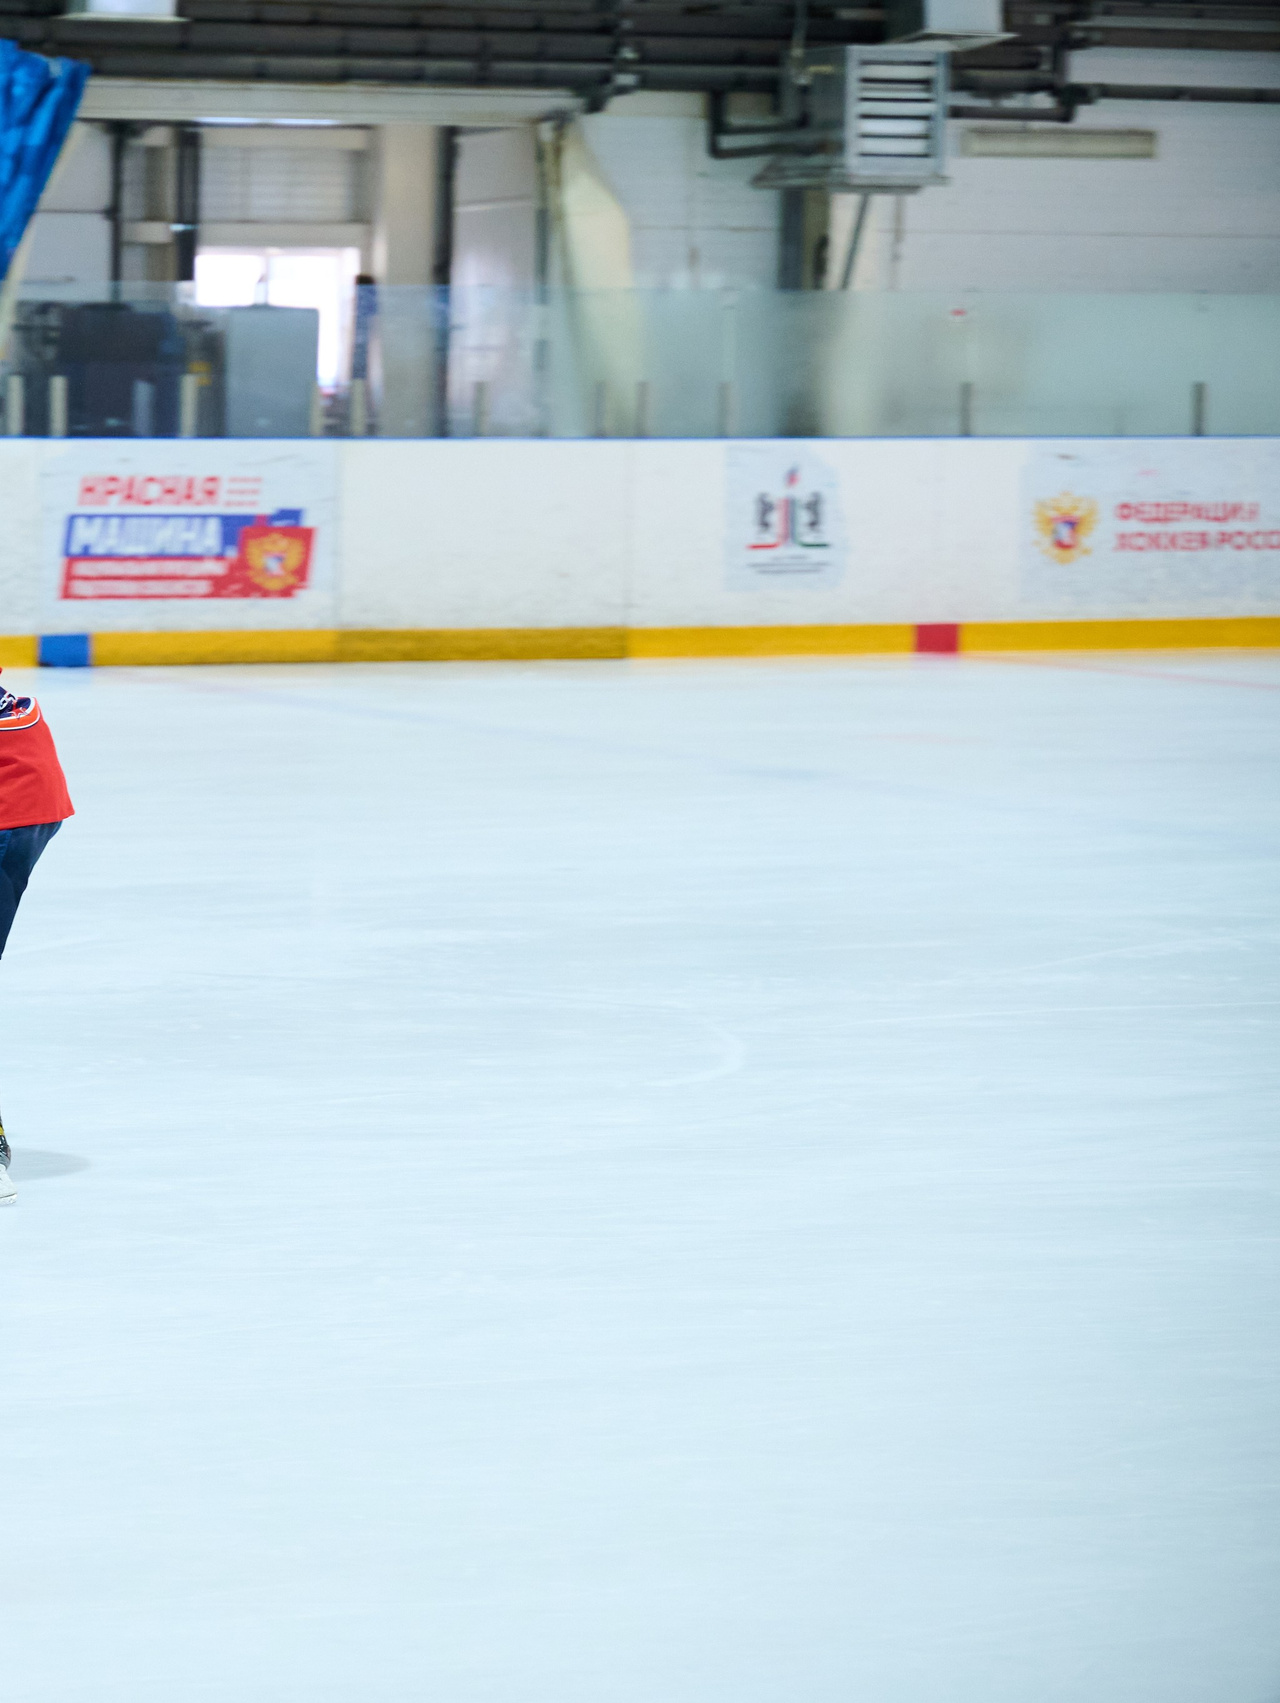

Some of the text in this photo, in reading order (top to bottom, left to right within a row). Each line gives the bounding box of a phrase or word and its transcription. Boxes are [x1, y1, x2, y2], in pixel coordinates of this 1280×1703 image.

[78, 475, 221, 506] КРАСНАЯ
[1116, 502, 1260, 523] ФЕДЕРАЦИЯ
[70, 516, 220, 555] МАШИНА
